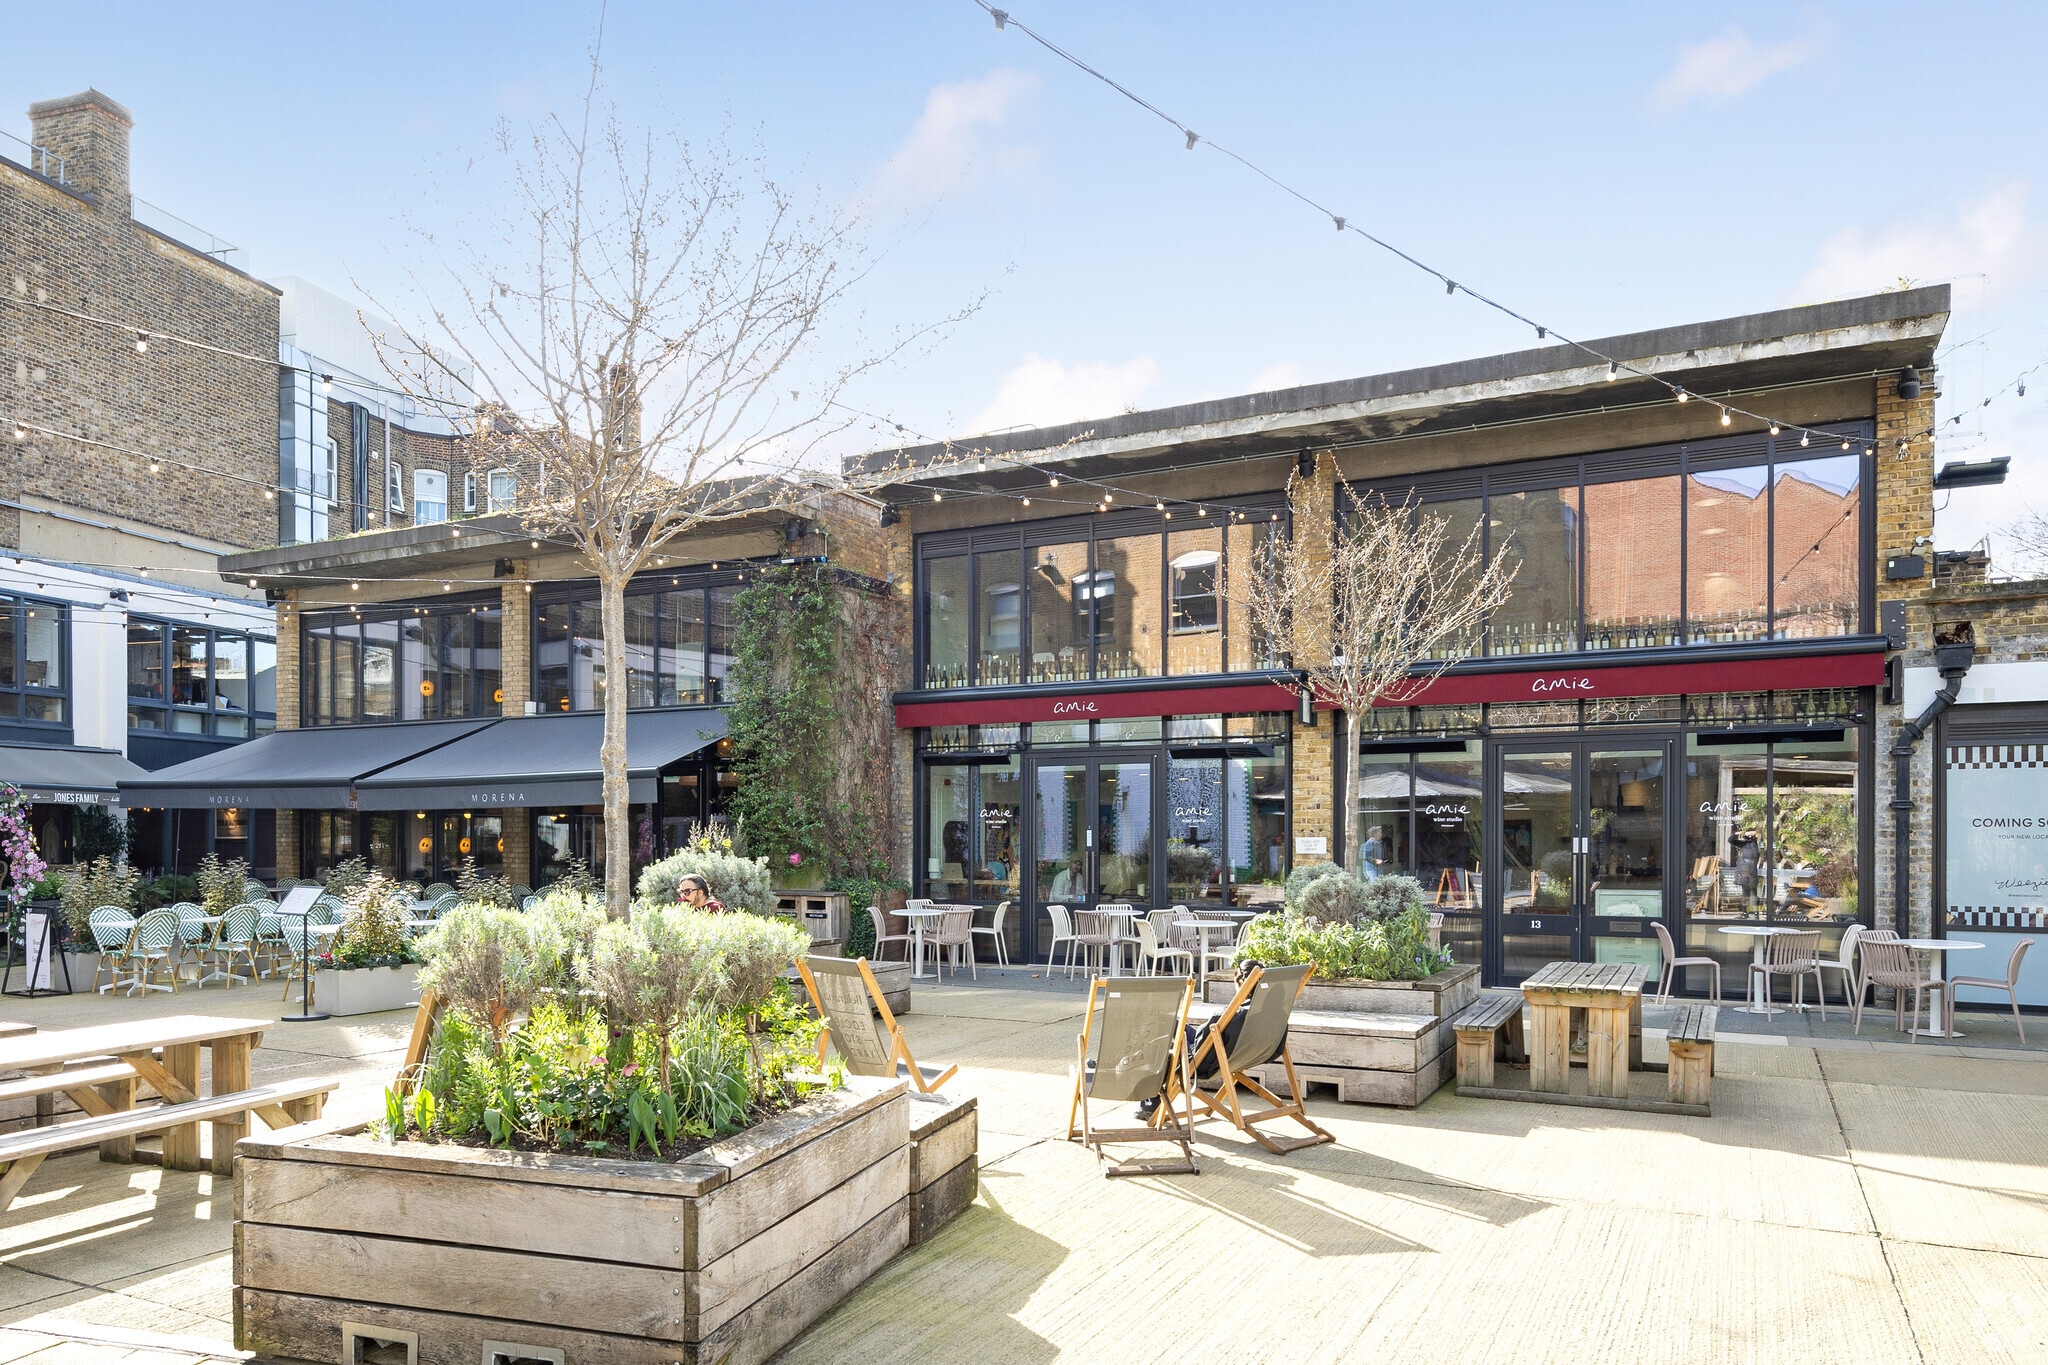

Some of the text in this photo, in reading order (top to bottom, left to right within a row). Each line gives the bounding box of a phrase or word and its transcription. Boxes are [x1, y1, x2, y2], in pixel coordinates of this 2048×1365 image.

[1533, 677, 1594, 692] amie
[1053, 701, 1098, 713] amie
[54, 793, 75, 803] JONES
[76, 794, 99, 804] FAMILY
[209, 796, 249, 804] MORENA
[471, 793, 525, 802] MORENA
[1175, 807, 1212, 815] amie
[1425, 805, 1470, 814] amie
[1700, 802, 1753, 812] amie
[980, 809, 1013, 817] amie
[1972, 818, 2048, 828] COMING S
[1530, 920, 1542, 928] 13
